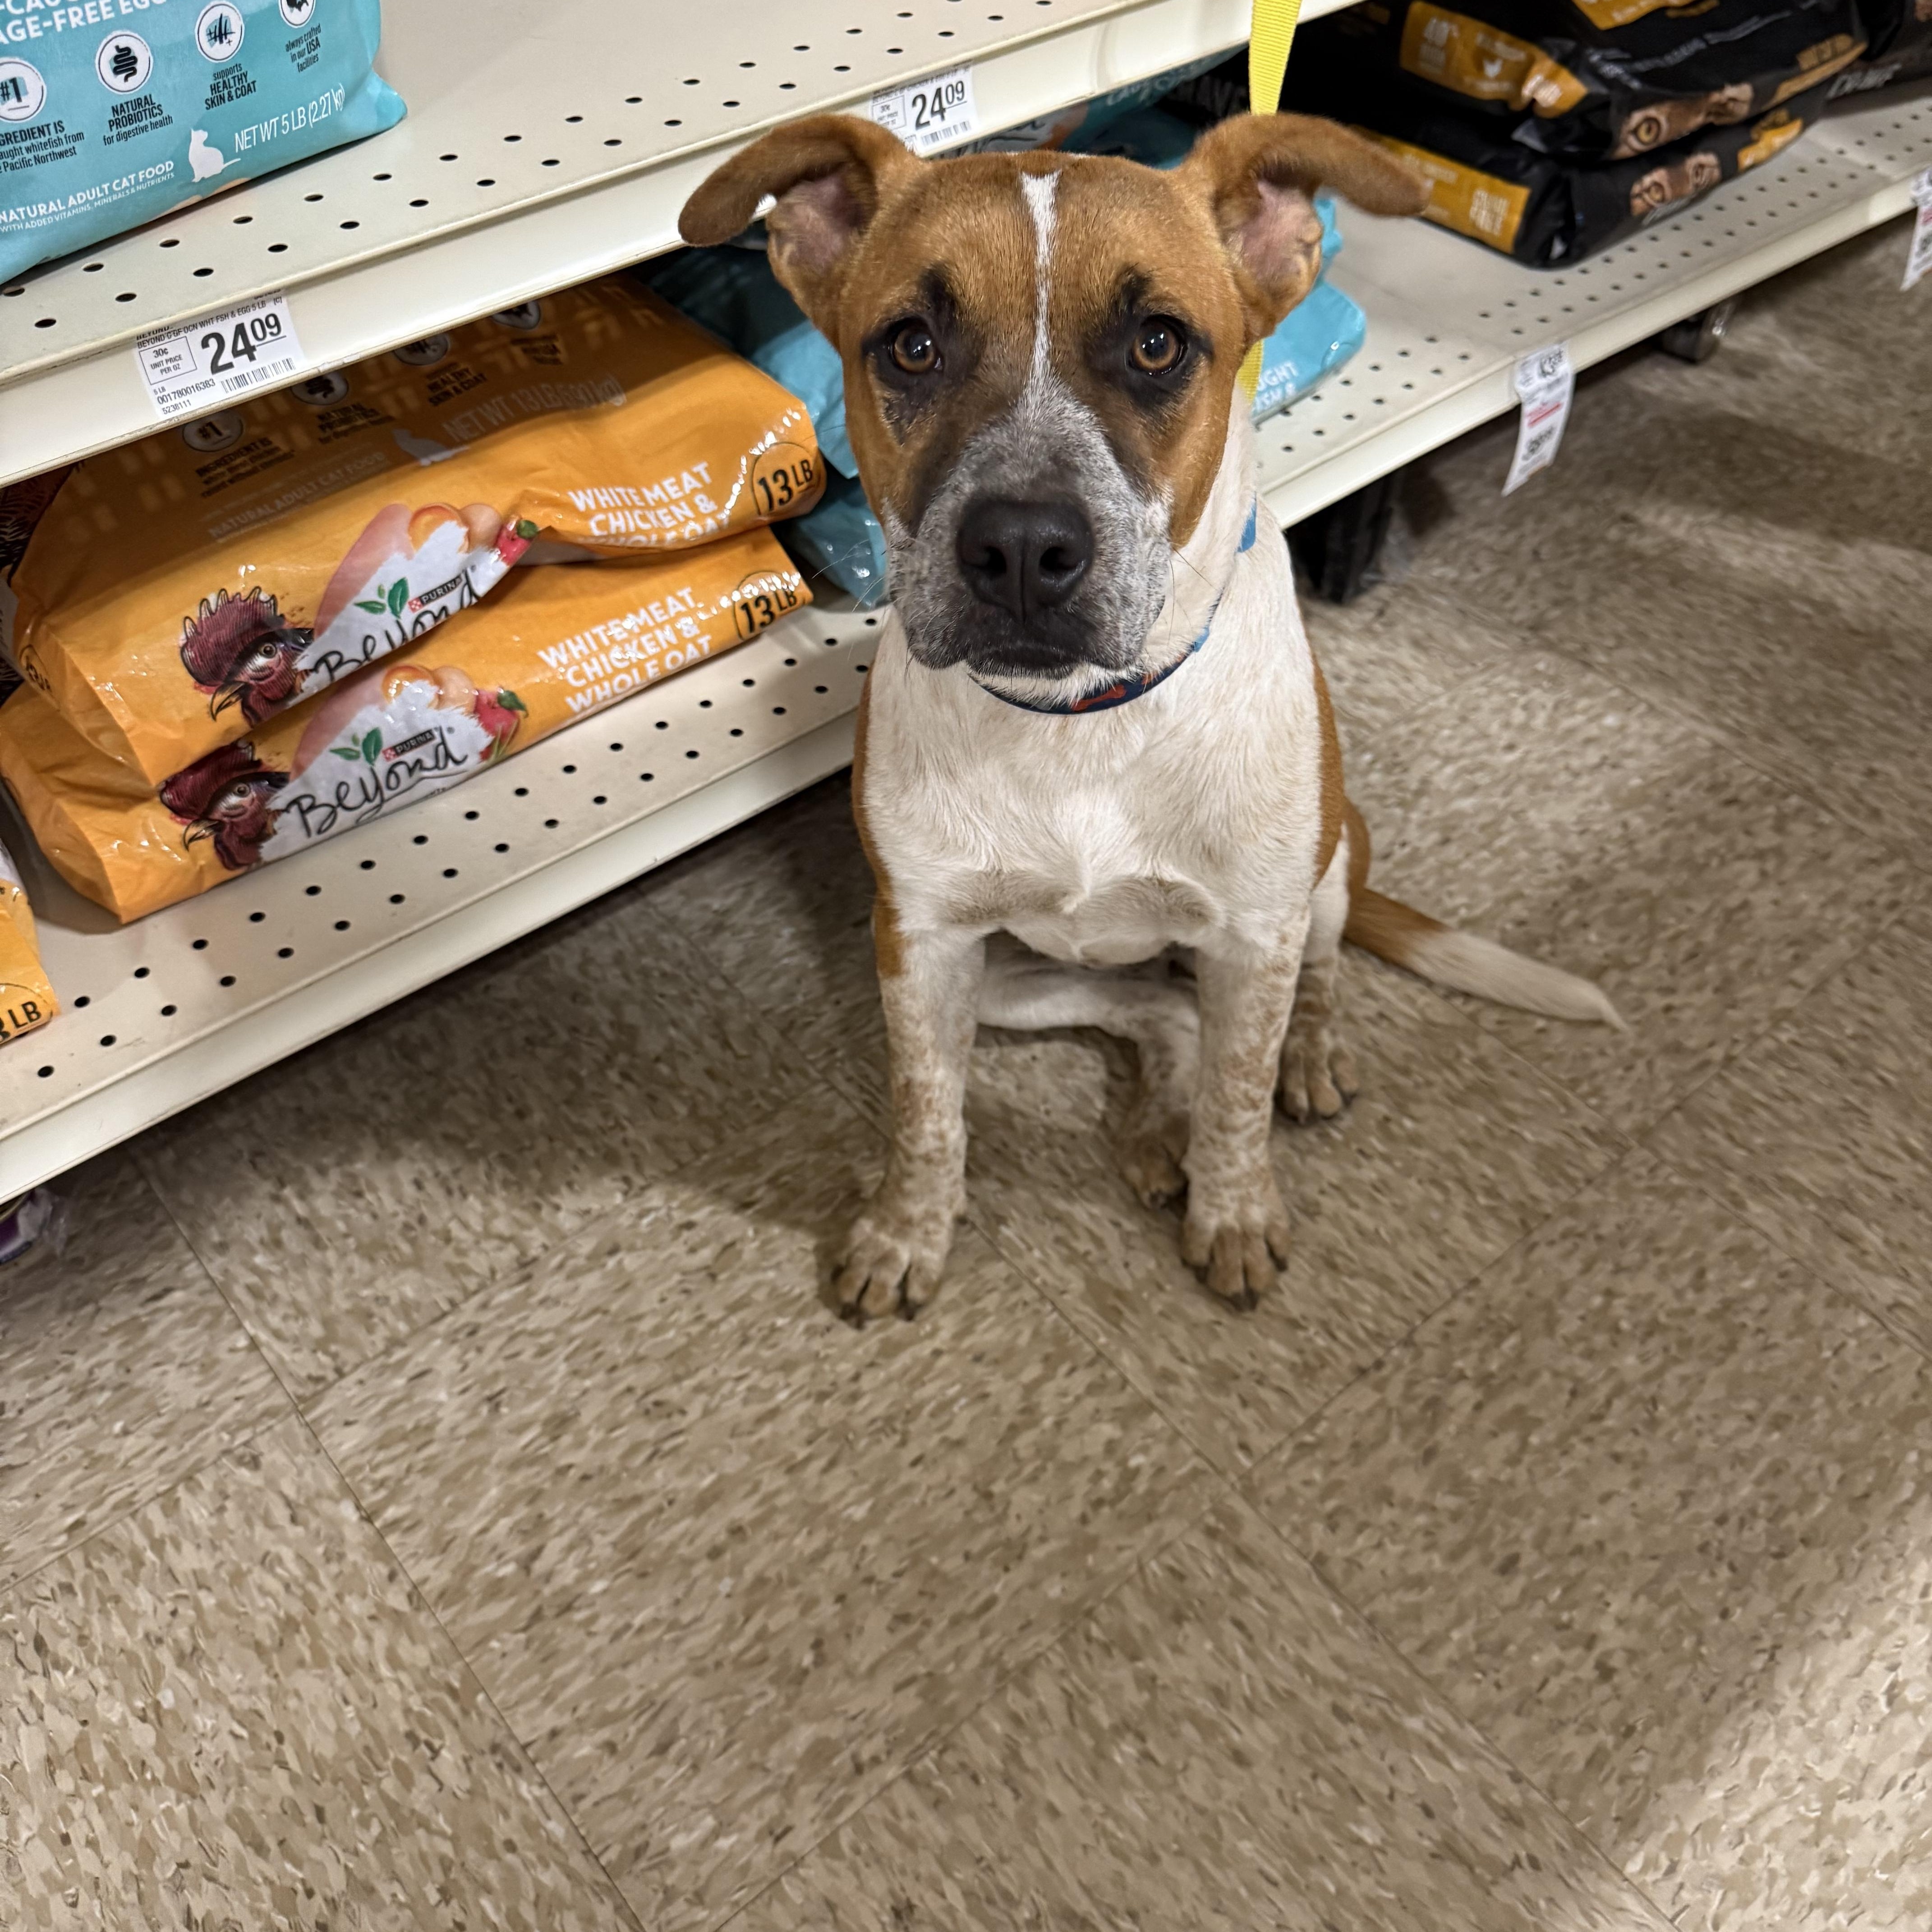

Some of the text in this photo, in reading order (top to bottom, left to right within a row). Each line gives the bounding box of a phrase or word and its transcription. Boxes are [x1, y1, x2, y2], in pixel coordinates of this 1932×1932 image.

[285, 23, 321, 52] always crafted
[290, 36, 321, 63] in our USA
[213, 63, 243, 81] supports
[297, 54, 319, 73] facilities
[0, 77, 22, 103] #1
[205, 80, 257, 110] SKIN & COAT
[210, 70, 248, 96] HEALTHY
[108, 104, 163, 132] PROBIOTICS
[111, 94, 156, 118] NATURAL
[53, 120, 65, 134] IS
[103, 114, 173, 146] for digestive health
[235, 125, 258, 153] NET
[260, 116, 279, 143] WT
[281, 113, 290, 135] 5
[290, 106, 307, 131] LB
[308, 92, 331, 129] (2.27
[24, 136, 64, 154] whitefish
[64, 131, 85, 145] from
[3, 156, 33, 172] Pacific
[34, 146, 77, 166] Northwest
[0, 161, 174, 224] NATURAL ADULT CAT FOOD
[0, 223, 23, 233] WITH
[25, 216, 54, 229] ADDED
[94, 189, 130, 207] MINERALS
[136, 172, 175, 191] NUTRIENTS
[137, 335, 166, 349] BEYOND
[199, 317, 215, 329] WHT
[216, 313, 229, 323] FSH
[230, 310, 236, 318] &
[237, 306, 251, 317] EGG
[252, 303, 257, 311] 5
[257, 300, 267, 309] LB
[150, 354, 183, 370] UNIT PRICE
[152, 348, 169, 358] 30¢
[160, 363, 181, 375] PER OZ
[442, 409, 486, 443] NET
[477, 395, 515, 427] WT
[568, 461, 712, 512] WHITE MEAT
[758, 459, 813, 512] 13 LB
[589, 493, 718, 536] CHICKEN &
[421, 576, 463, 604] PURINA
[740, 588, 797, 634] 13 LB
[537, 586, 697, 669] WHITE MEAT
[566, 617, 701, 687] CHICKEN &
[565, 635, 712, 713] WHOLE OAT
[285, 725, 469, 839] Beyond
[8, 1001, 41, 1029] LB
